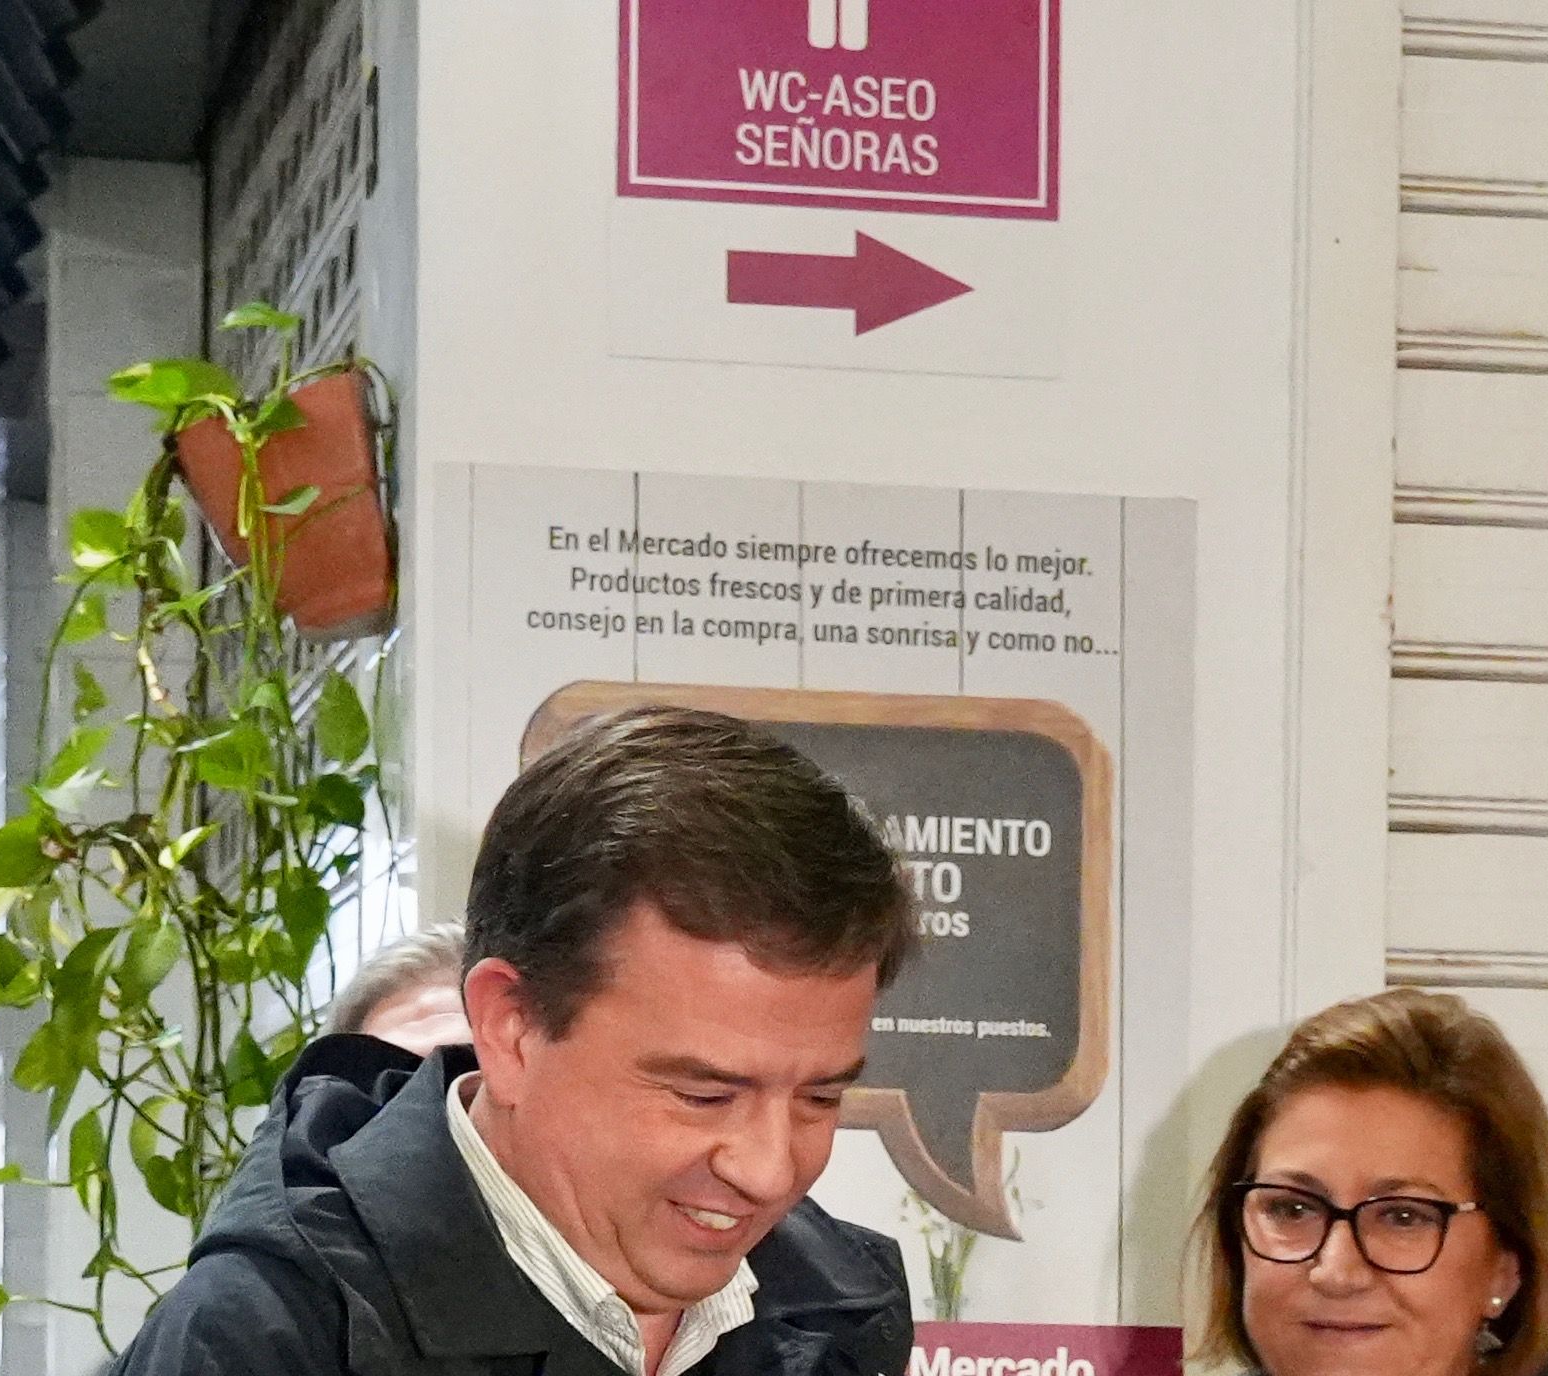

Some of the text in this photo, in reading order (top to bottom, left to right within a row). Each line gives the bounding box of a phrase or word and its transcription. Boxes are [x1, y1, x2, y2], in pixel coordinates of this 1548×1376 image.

[739, 67, 937, 121] WC-ASEO
[735, 119, 939, 177] SEÑORAS
[549, 526, 1092, 580] En el Mercado siempre ofrecemos lo mejor.
[571, 567, 1071, 618] Productos frescos y de primera calidad,
[527, 607, 1119, 655] consejo en la compra, una sonrisa y como no...
[883, 815, 1052, 857] AMIENTO
[908, 861, 963, 903] TO
[871, 1016, 1052, 1040] en nuestros puestos.
